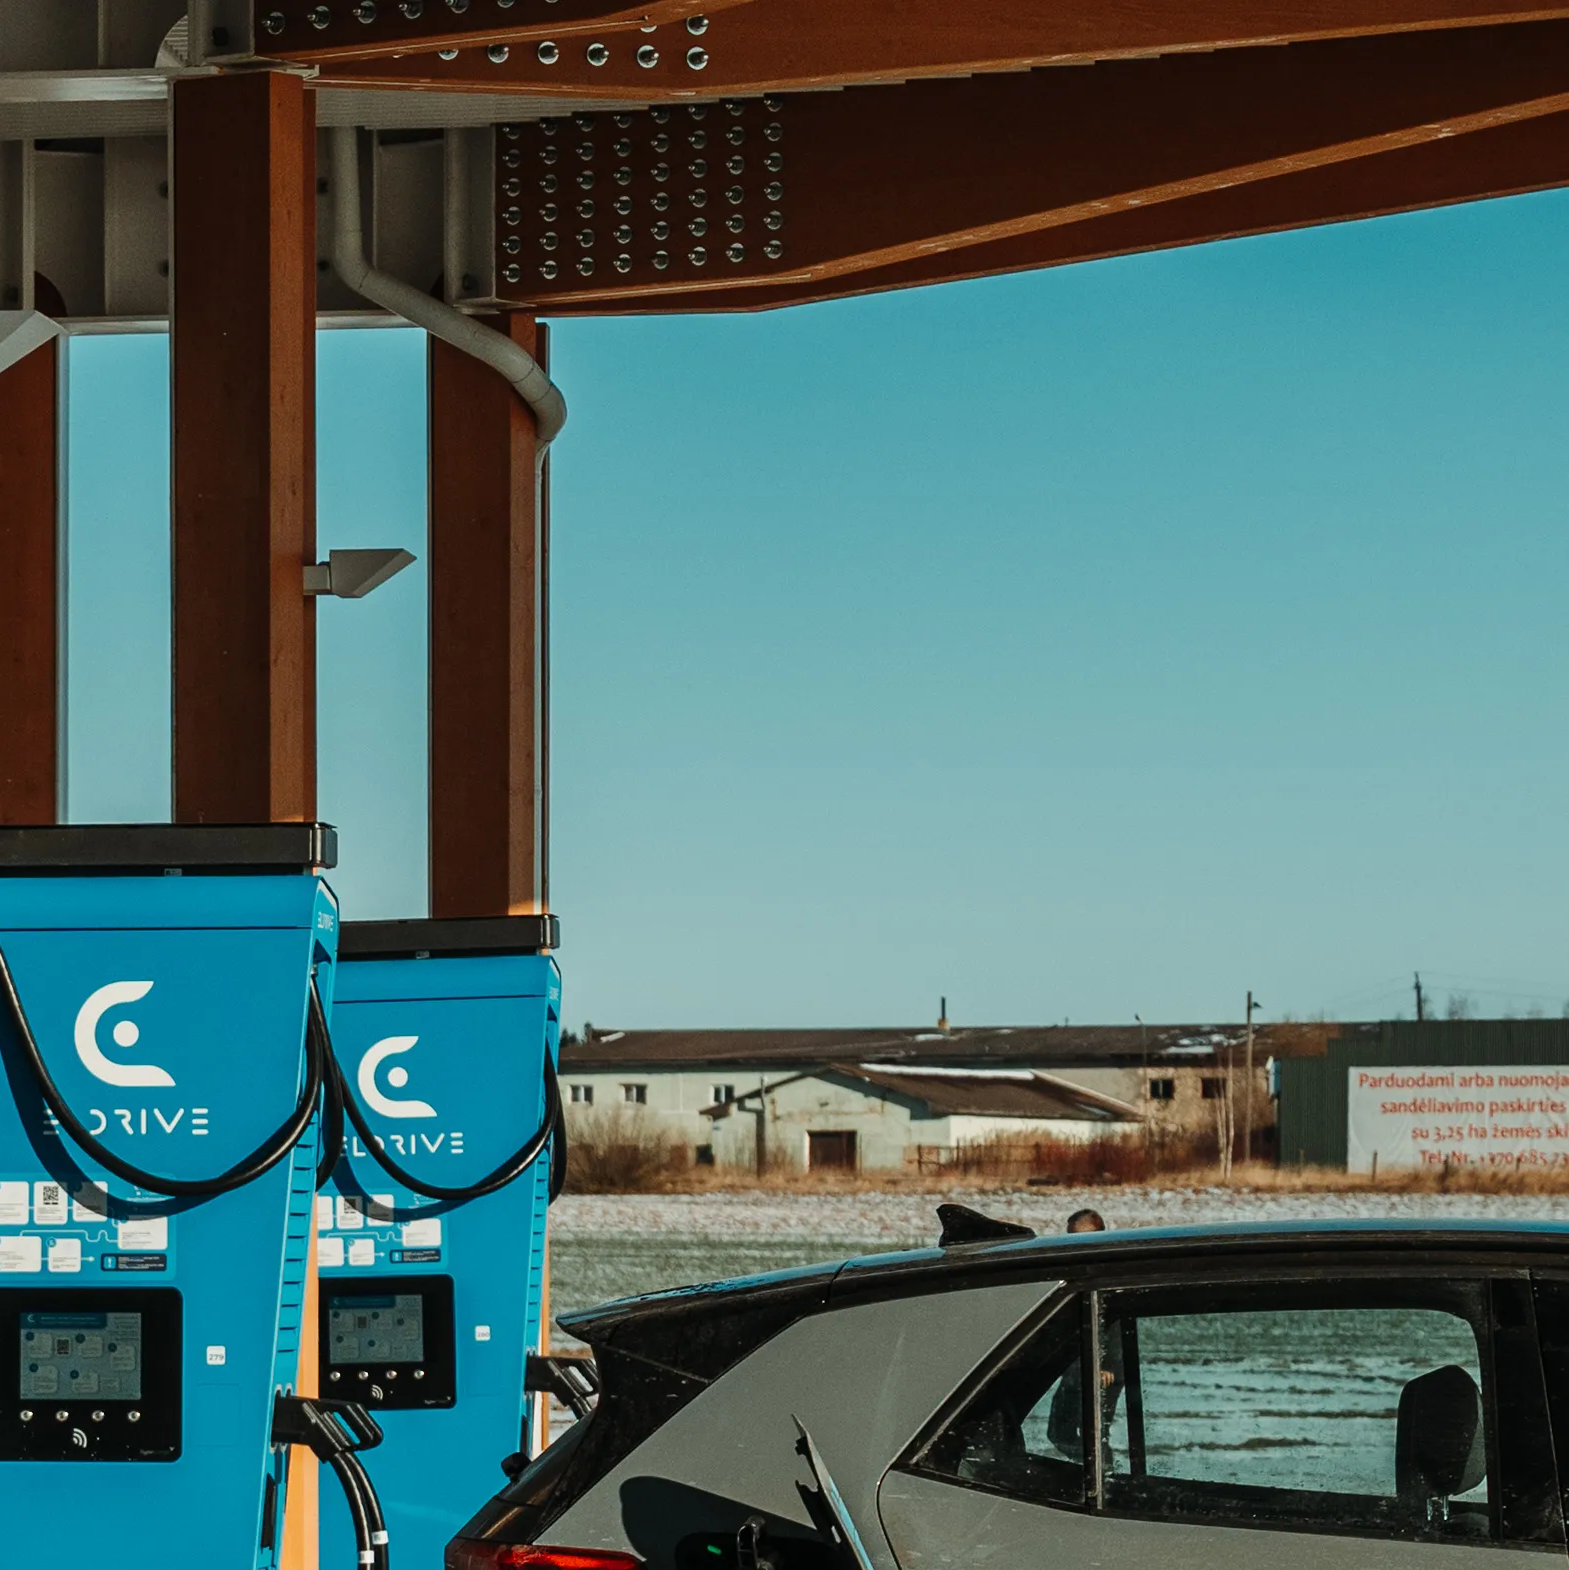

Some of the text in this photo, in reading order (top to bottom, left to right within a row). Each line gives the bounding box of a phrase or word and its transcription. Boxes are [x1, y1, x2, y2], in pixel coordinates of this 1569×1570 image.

[1358, 1073, 1455, 1088] Parduodami
[1459, 1073, 1494, 1087] arba
[1380, 1098, 1567, 1116] sandėliavimo paskirties
[43, 1108, 209, 1135] EDRIVE
[1412, 1127, 1429, 1139] su
[1433, 1127, 1464, 1141] 3,25
[1468, 1124, 1488, 1138] ha
